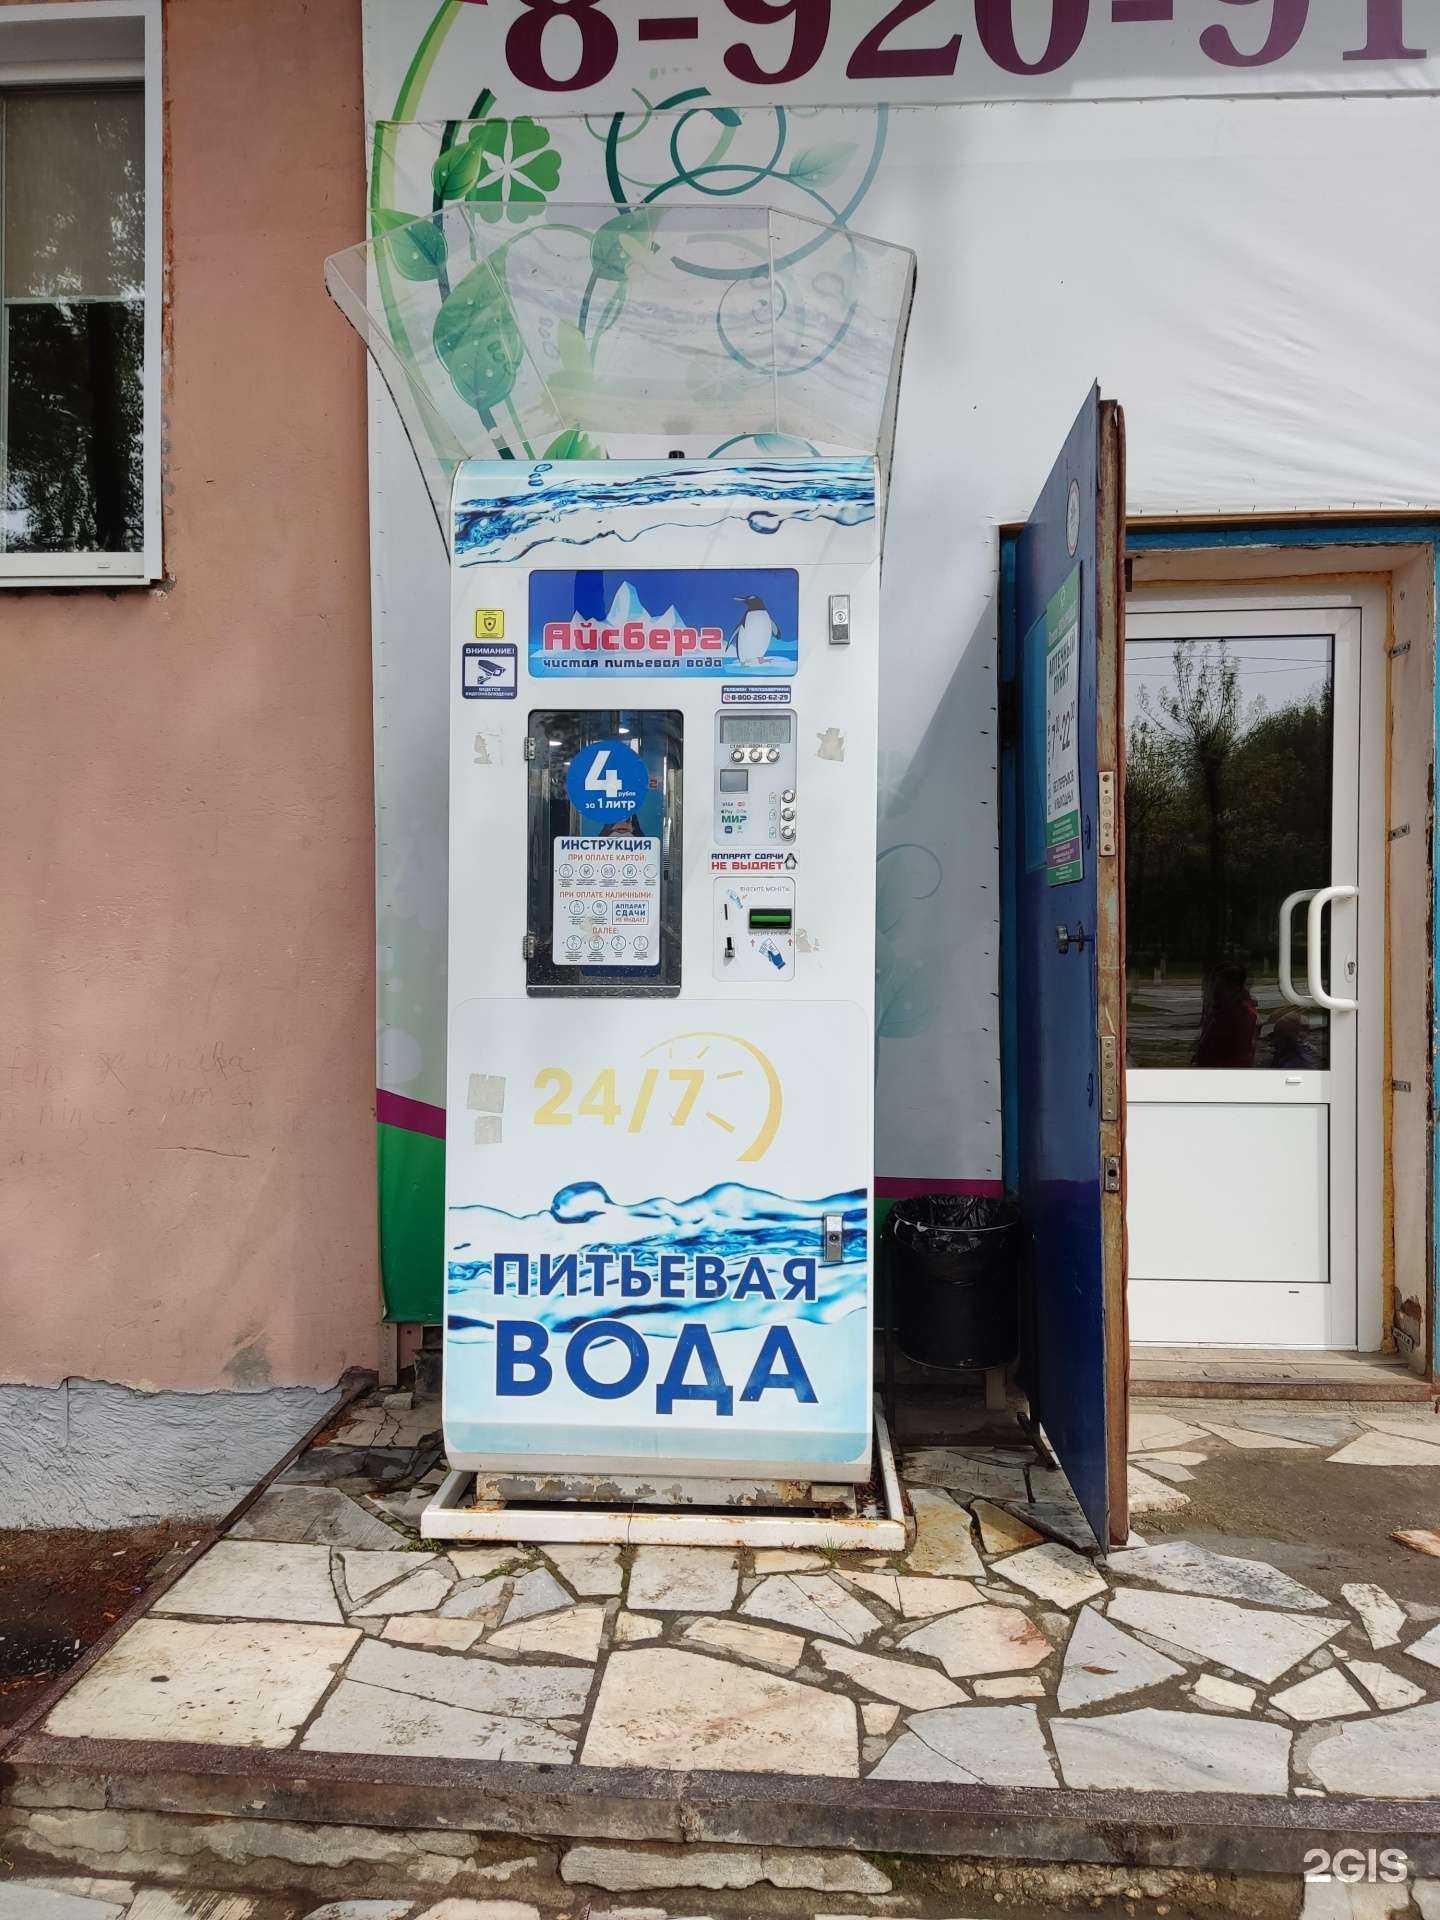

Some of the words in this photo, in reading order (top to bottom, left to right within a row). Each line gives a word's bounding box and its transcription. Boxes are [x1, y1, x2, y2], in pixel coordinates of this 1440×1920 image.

[544, 622, 722, 657] Айсберг
[465, 647, 515, 655] ВНИМАНИЕ!
[544, 659, 599, 668] чистая
[605, 659, 680, 668] питьевая
[686, 657, 722, 668] вода
[584, 750, 622, 798] 4
[597, 798, 603, 809] 1
[605, 800, 636, 811] литр
[721, 815, 747, 823] МИР
[561, 840, 652, 852] ИНСТРУКЦИЯ
[711, 861, 727, 870] НЕ
[731, 861, 784, 870] ВЫДАЕТ
[560, 891, 574, 899] ПРИ
[576, 891, 603, 899] ОПЛАТЕ
[532, 1067, 705, 1133] 24/7
[493, 1253, 817, 1301] ПИТЬЕВАЯ
[496, 1319, 819, 1416] ВОДА
